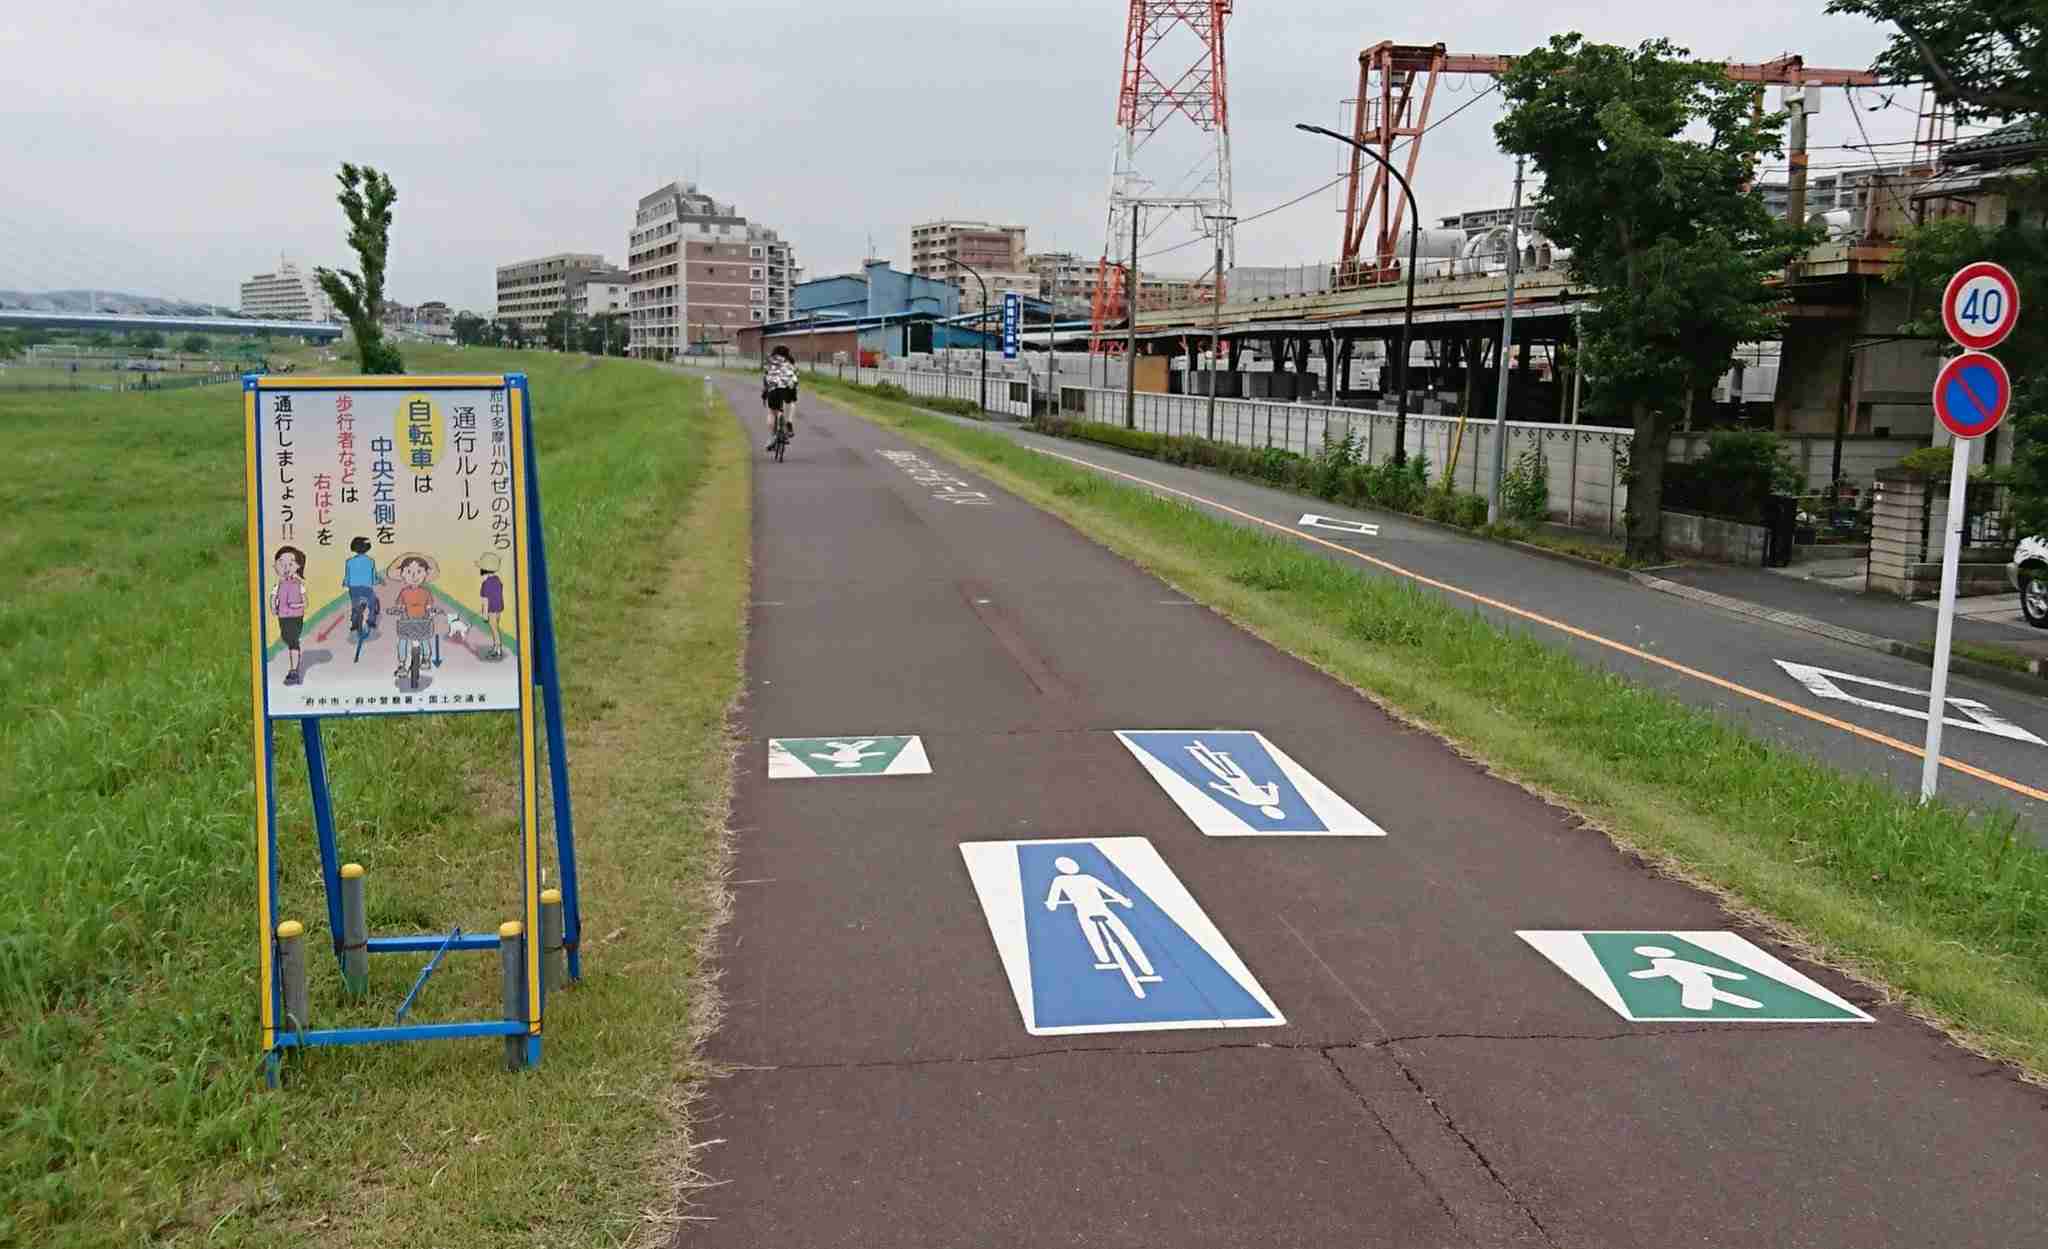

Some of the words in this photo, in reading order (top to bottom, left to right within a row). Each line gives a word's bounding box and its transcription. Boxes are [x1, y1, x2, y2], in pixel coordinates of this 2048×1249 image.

[1961, 288, 2002, 325] 40
[336, 395, 360, 504] 歩行者などは
[371, 436, 396, 545] 中央左側を
[408, 400, 434, 493] 自転車は
[453, 406, 480, 521] 通行ルール
[489, 391, 512, 550] 府中多摩川かぜのみち
[313, 473, 334, 546] 右はじを
